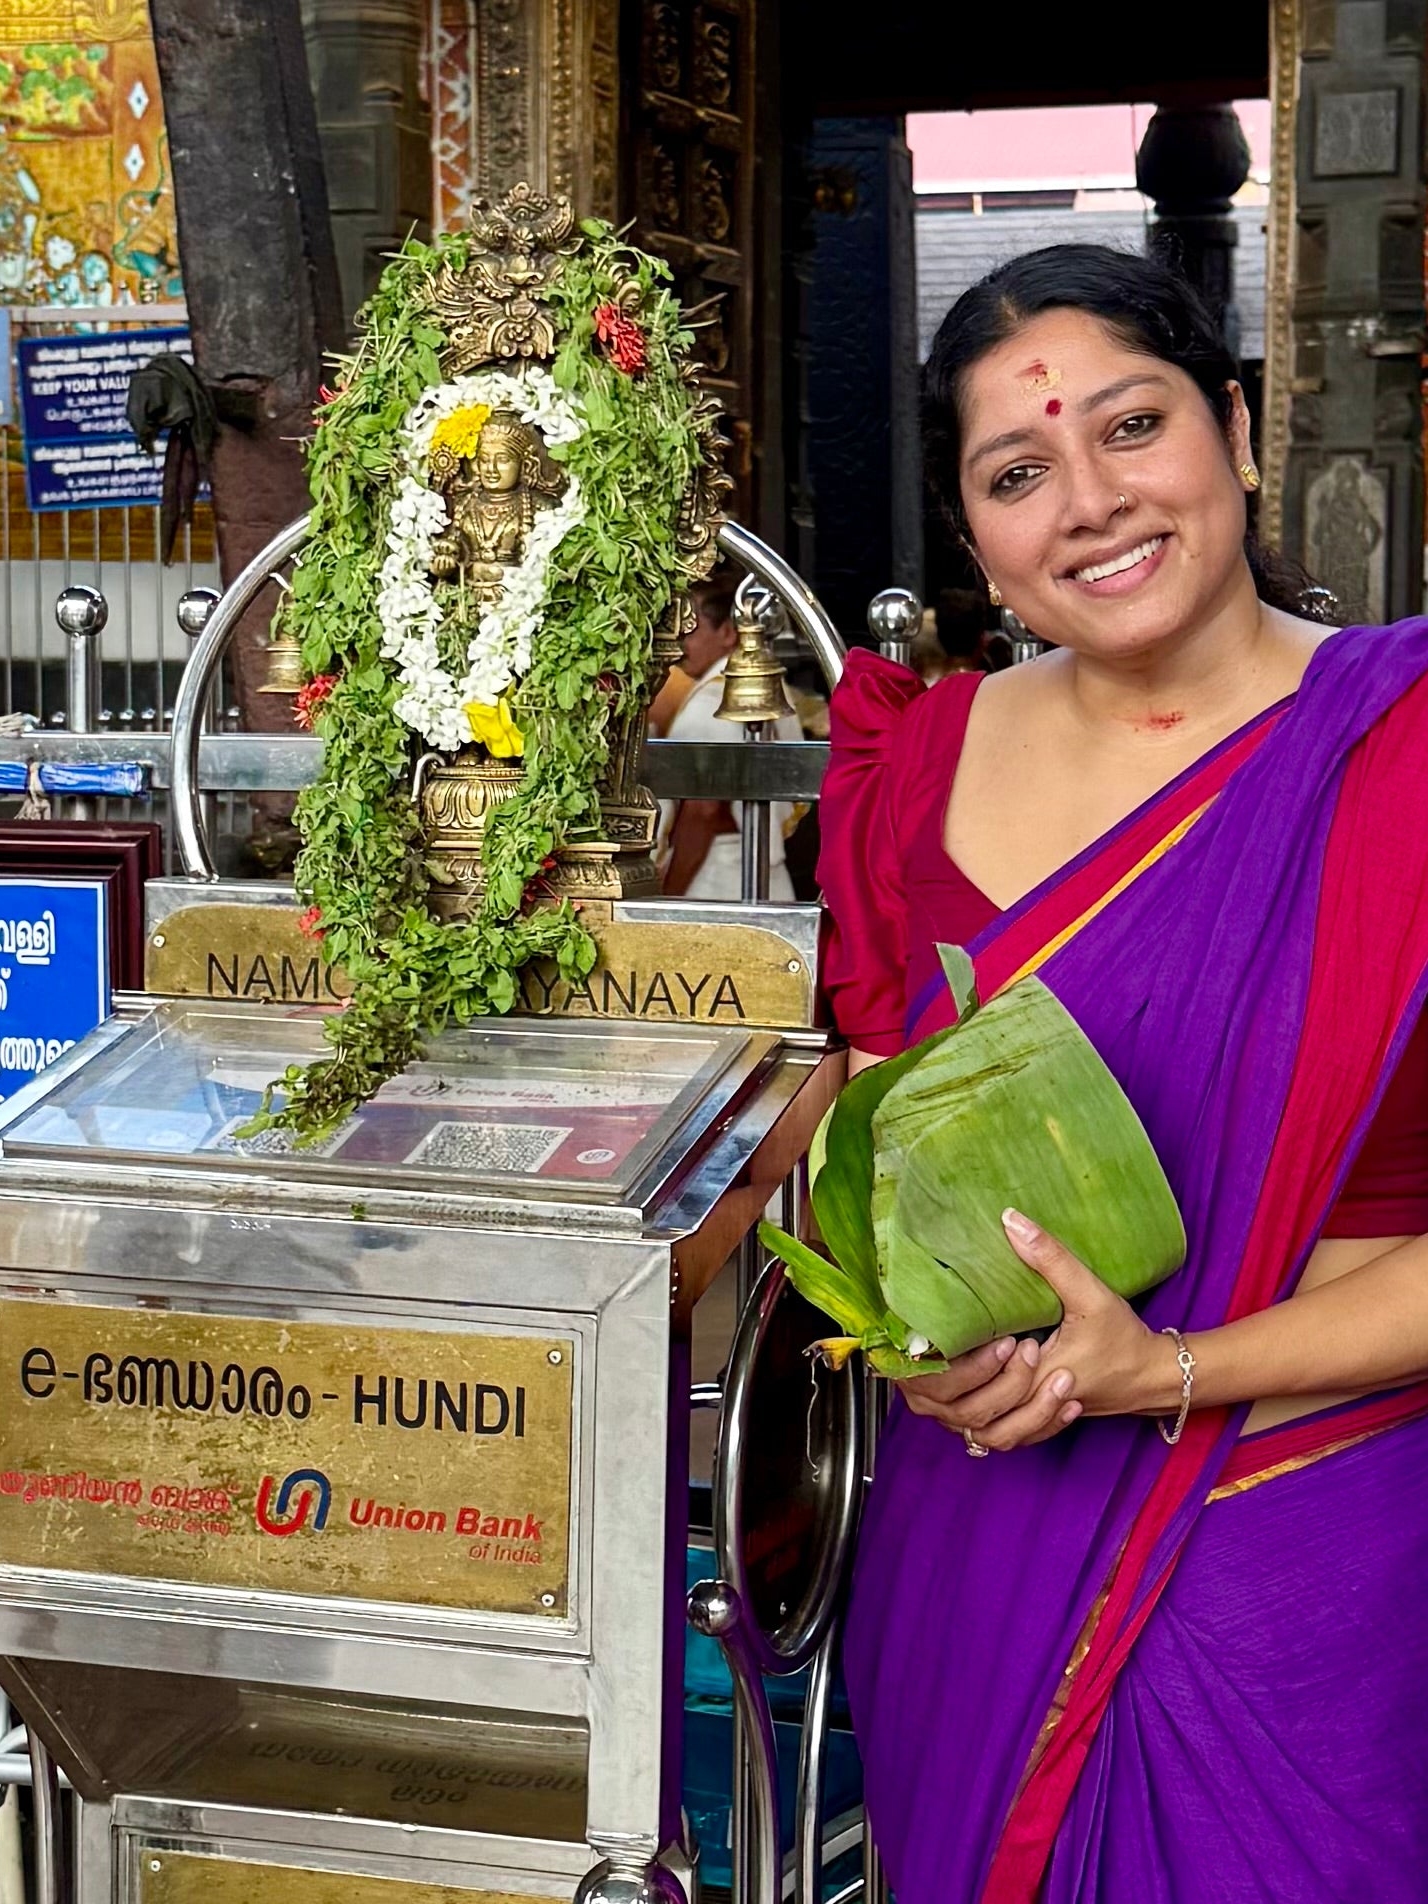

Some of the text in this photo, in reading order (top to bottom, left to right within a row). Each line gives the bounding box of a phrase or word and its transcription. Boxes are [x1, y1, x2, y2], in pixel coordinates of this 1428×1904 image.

[32, 376, 131, 395] KEEP YOUR VALU
[353, 1374, 525, 1437] HUNDI
[349, 1497, 545, 1543] Union Bank
[468, 1540, 543, 1566] of India
